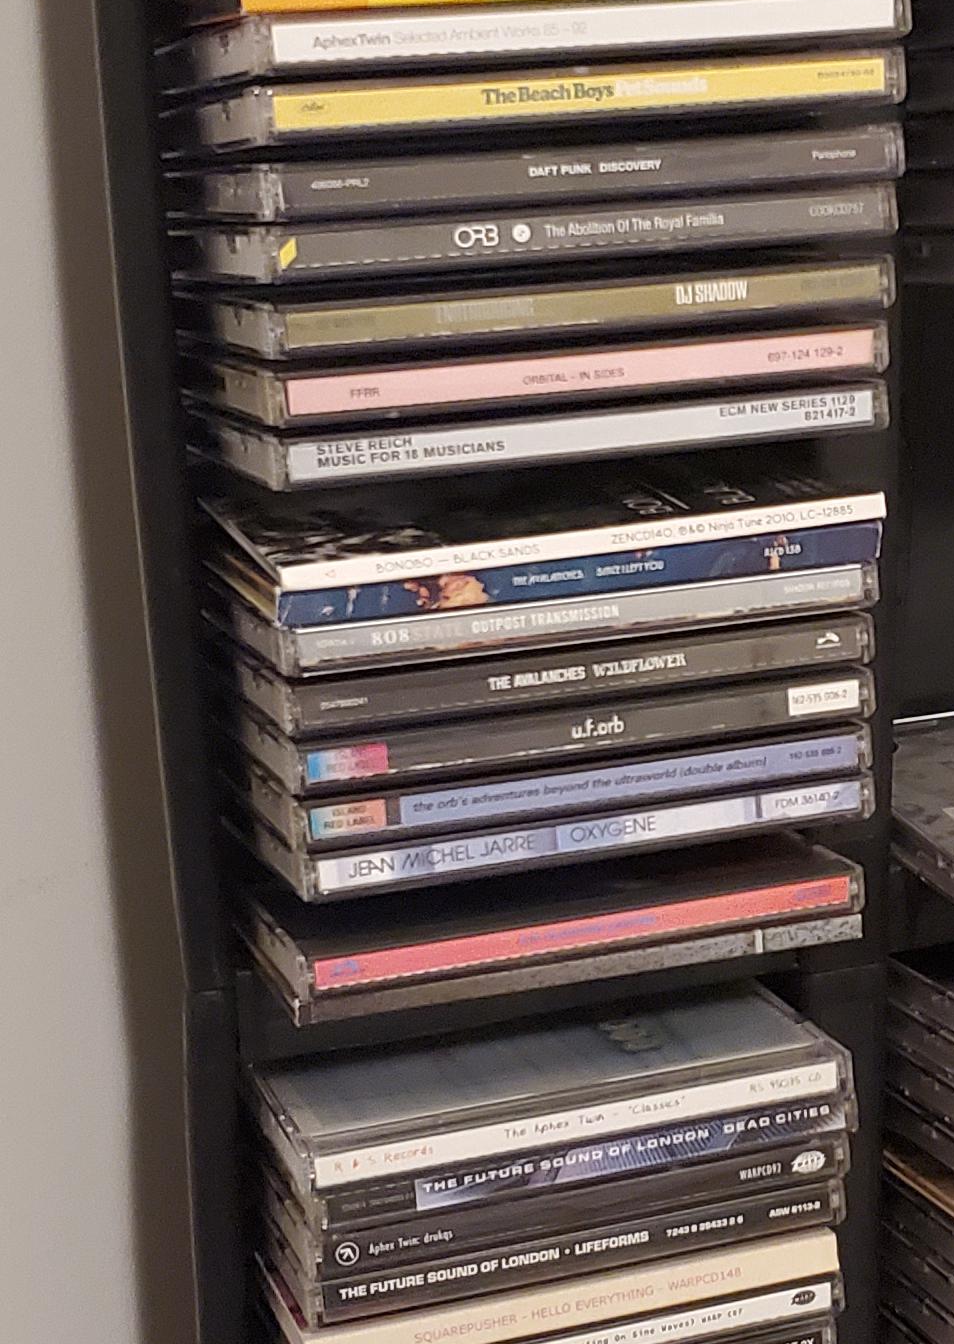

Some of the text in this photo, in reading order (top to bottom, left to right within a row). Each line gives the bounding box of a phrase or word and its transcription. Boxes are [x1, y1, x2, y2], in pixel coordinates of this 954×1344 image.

[483, 81, 615, 108] The Beach Boys
[529, 163, 592, 180] DAFT PUNK
[599, 159, 662, 175] DISCOVERY
[675, 280, 749, 305] DJ SHADOW
[316, 437, 412, 456] STEVE REICH
[375, 542, 541, 574] BONOBO BLACK SANDS
[471, 602, 619, 634] OUTPOST TRANSMISSION
[371, 630, 409, 648] 808
[571, 715, 625, 740] u.f.orb
[570, 815, 656, 843] OXYGENE
[349, 833, 535, 879] JEAN MICHEL JARRE
[339, 1230, 649, 1301] THE FUTURE SOUND OF LONDON LIFEFORMS
[414, 1266, 742, 1344] SQUAREPUSHER HELLO EVERYTHING WARPCD148
